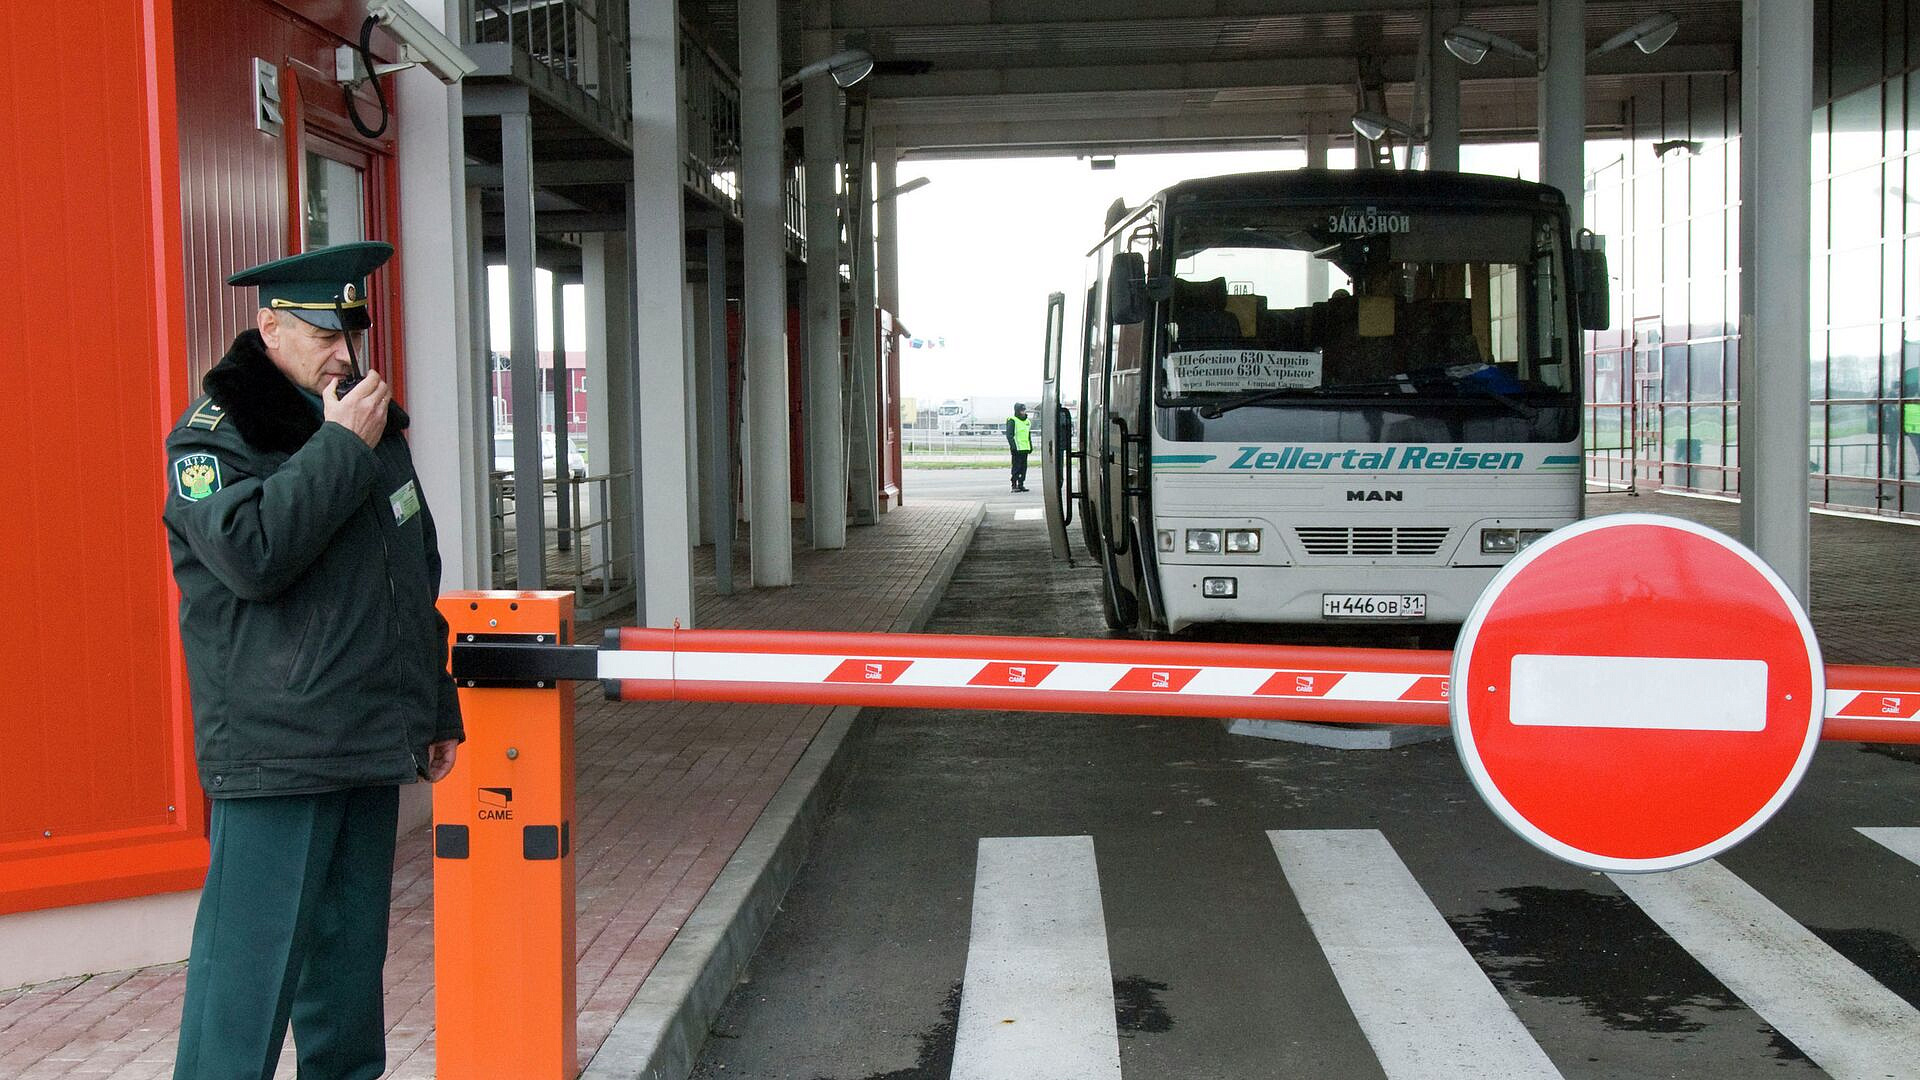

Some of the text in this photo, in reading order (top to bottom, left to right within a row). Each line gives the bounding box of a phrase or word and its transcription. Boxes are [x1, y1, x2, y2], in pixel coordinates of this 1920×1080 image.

[1240, 351, 1264, 365] 630
[1267, 353, 1310, 368] Харків
[1237, 363, 1261, 377] 630
[1228, 446, 1525, 470] Zellertal Reisen
[1346, 490, 1404, 502] MAN
[478, 810, 513, 820] CAME
